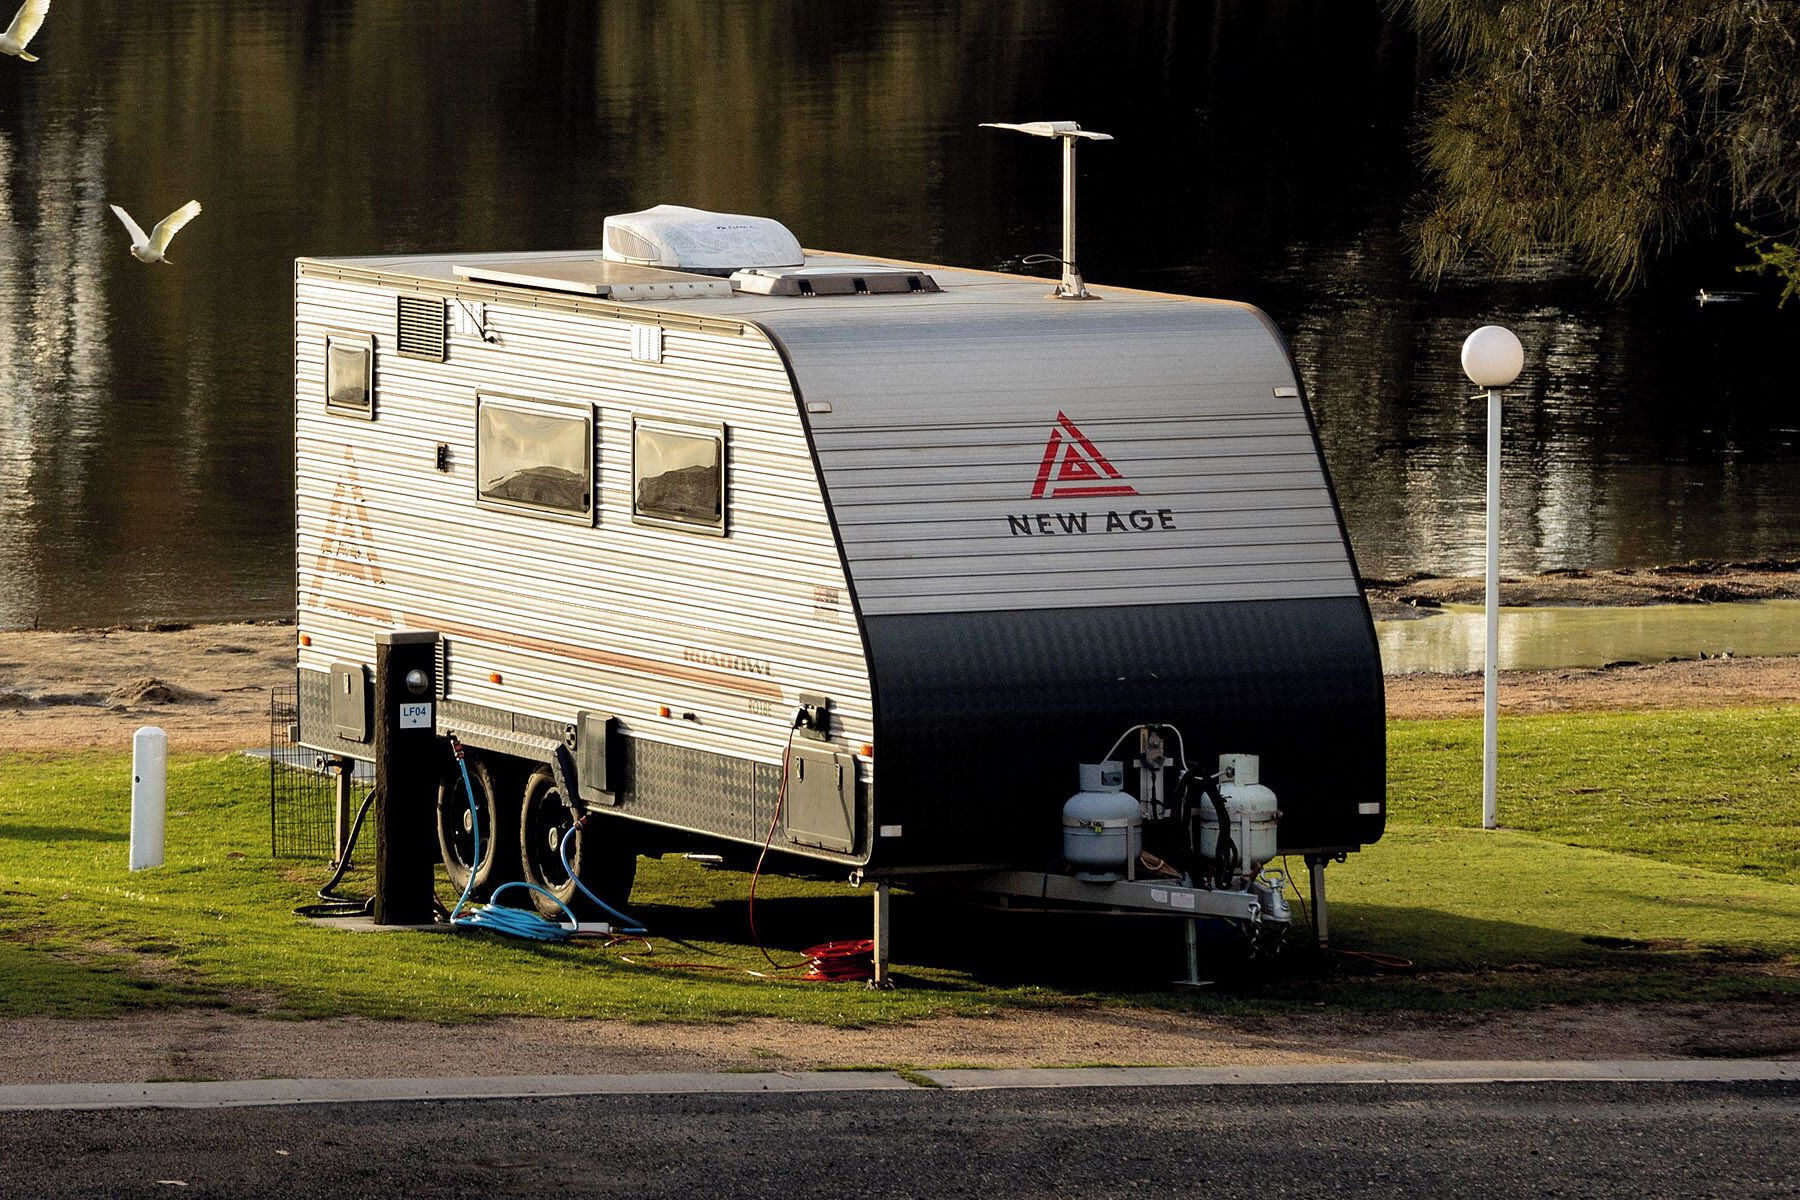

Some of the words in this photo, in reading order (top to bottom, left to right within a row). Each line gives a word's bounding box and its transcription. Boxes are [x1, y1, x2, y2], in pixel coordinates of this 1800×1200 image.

[1006, 512, 1088, 536] NEW
[1105, 508, 1177, 532] AGE
[403, 706, 427, 717] LF04
